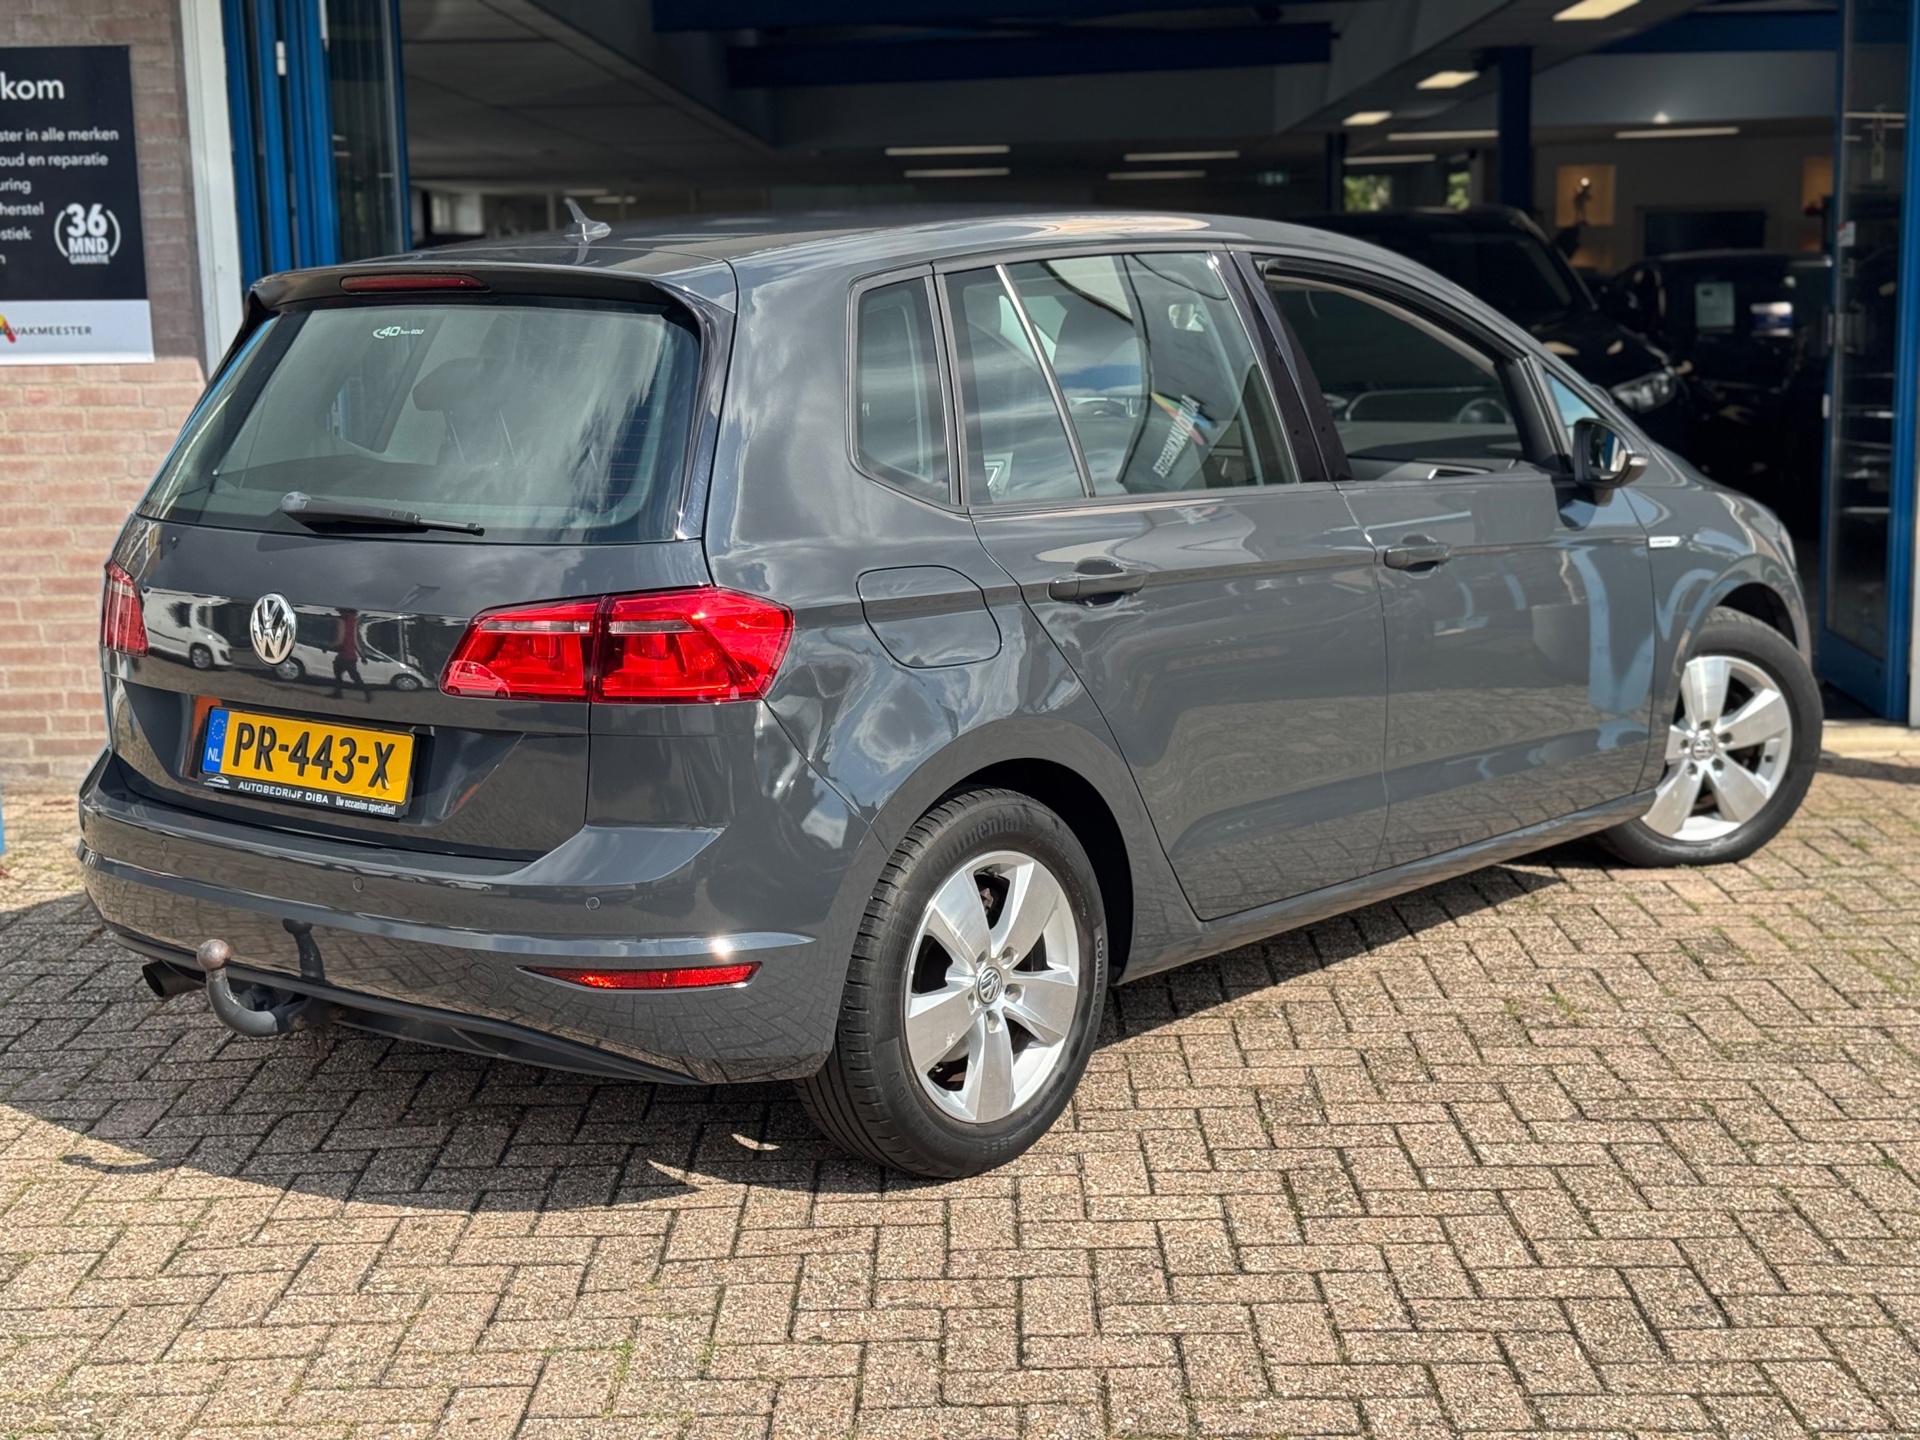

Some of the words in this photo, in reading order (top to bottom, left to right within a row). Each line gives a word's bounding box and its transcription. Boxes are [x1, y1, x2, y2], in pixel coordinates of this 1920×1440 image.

[0, 71, 65, 100] kom
[25, 128, 39, 142] in
[41, 126, 65, 142] alle
[68, 127, 119, 141] merken
[0, 152, 25, 167] oud
[27, 155, 45, 167] en
[48, 153, 109, 169] reparatie
[66, 203, 108, 238] 36
[0, 226, 33, 241] stiek
[67, 236, 109, 254] MND
[69, 254, 110, 265] GARANTIE
[207, 747, 221, 763] NL
[232, 722, 396, 790] PR-443-X
[238, 781, 303, 800] AUTOBEDRIJF
[305, 792, 329, 804] DIBA
[335, 795, 344, 806] Uw
[345, 799, 368, 812] occasion
